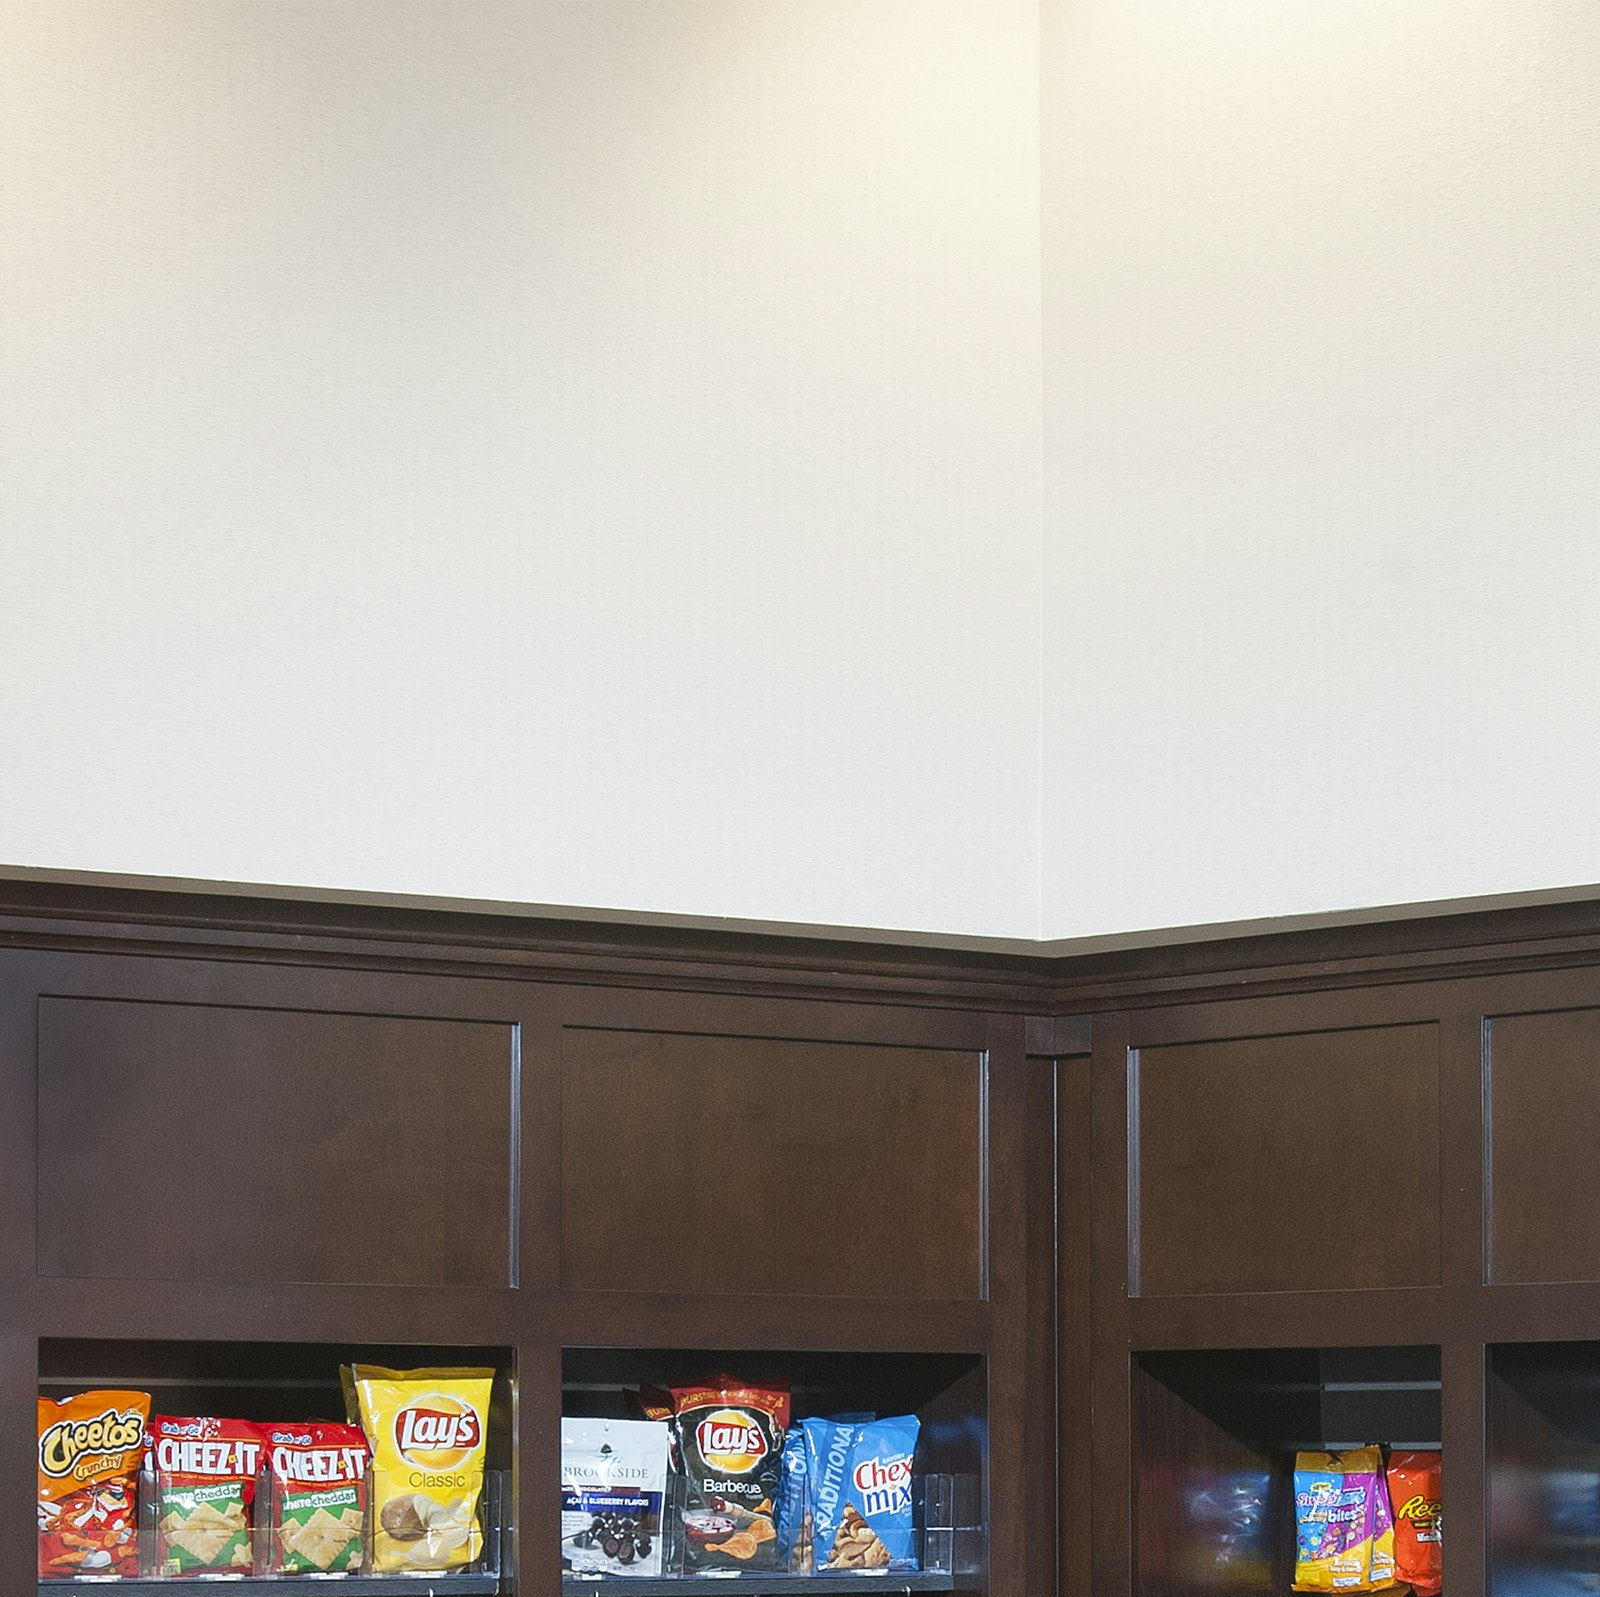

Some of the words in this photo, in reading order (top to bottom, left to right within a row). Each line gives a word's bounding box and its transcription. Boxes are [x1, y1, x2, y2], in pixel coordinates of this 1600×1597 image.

[40, 1411, 141, 1474] Cheetos
[401, 1409, 476, 1450] Lay's
[703, 1423, 760, 1454] Lay's
[73, 1454, 122, 1481] Crunchy
[409, 1472, 465, 1488] Classic
[855, 1453, 915, 1491] Chex
